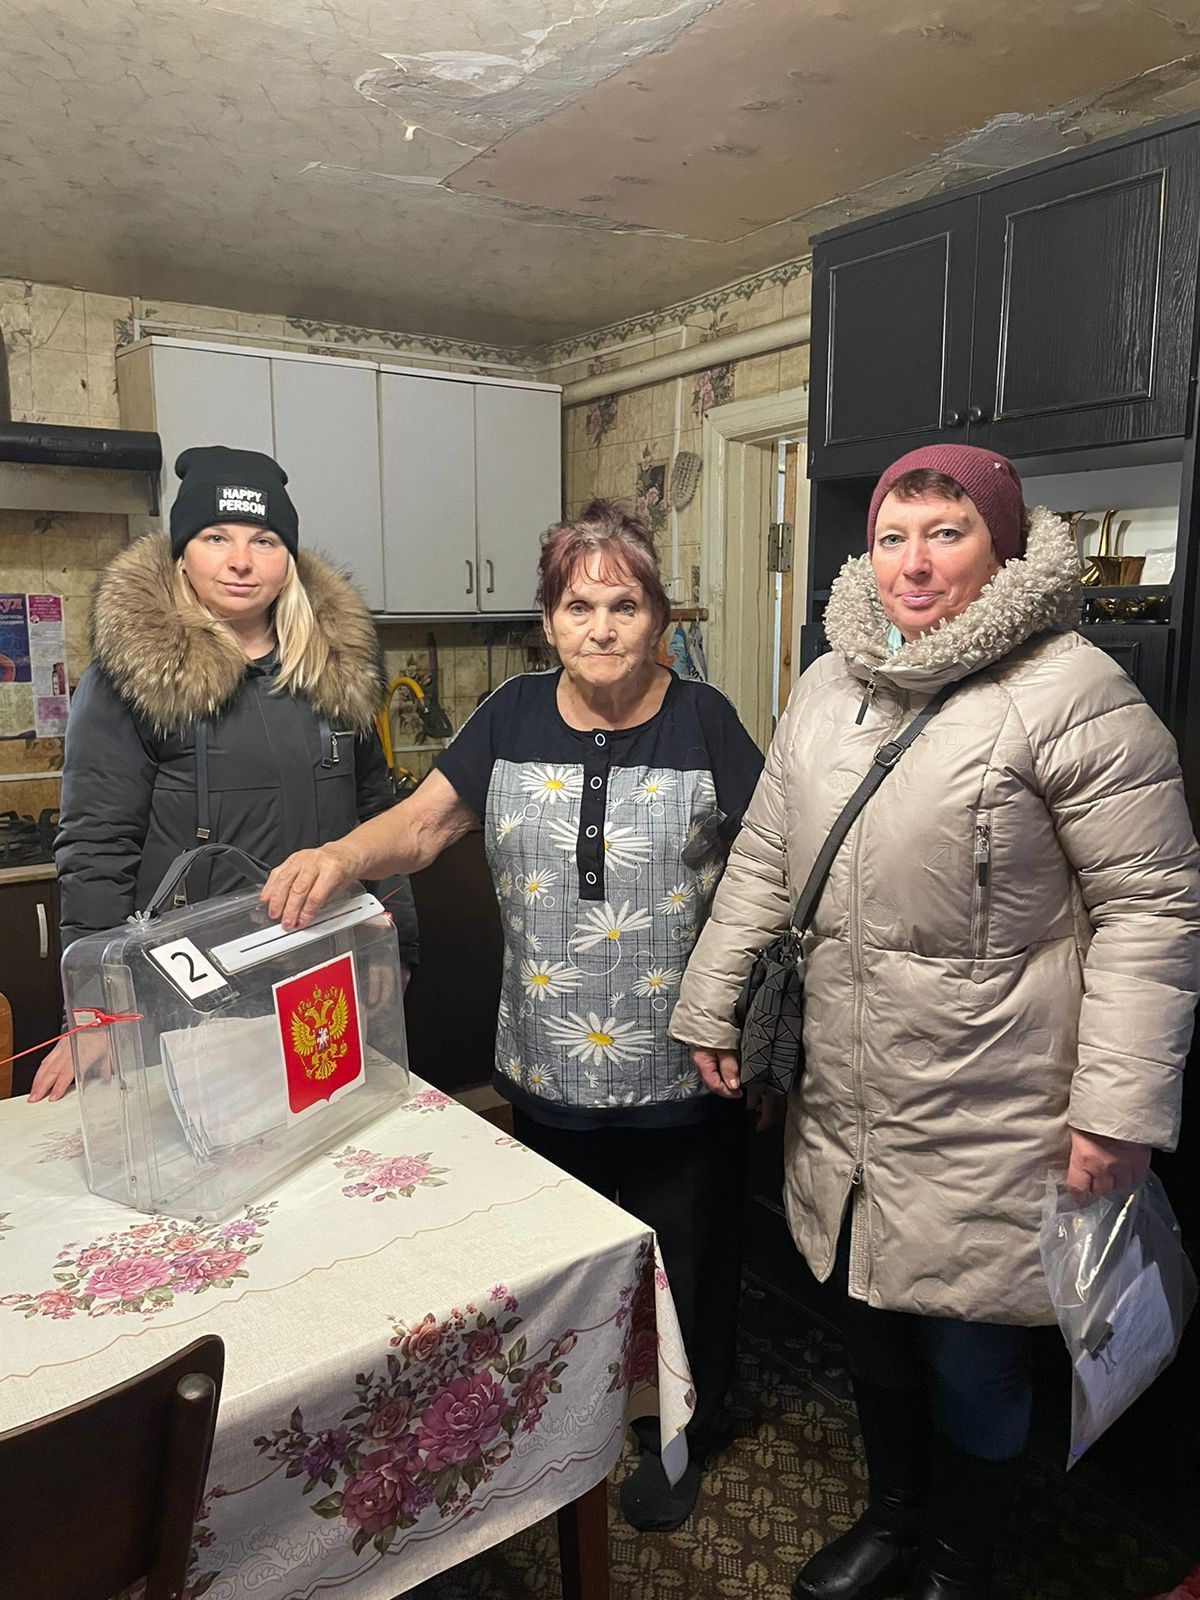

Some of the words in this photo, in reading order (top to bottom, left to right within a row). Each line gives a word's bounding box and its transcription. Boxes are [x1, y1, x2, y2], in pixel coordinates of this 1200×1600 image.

[223, 488, 262, 502] HAPPY
[219, 500, 266, 516] PERSON
[170, 951, 208, 983] 2
